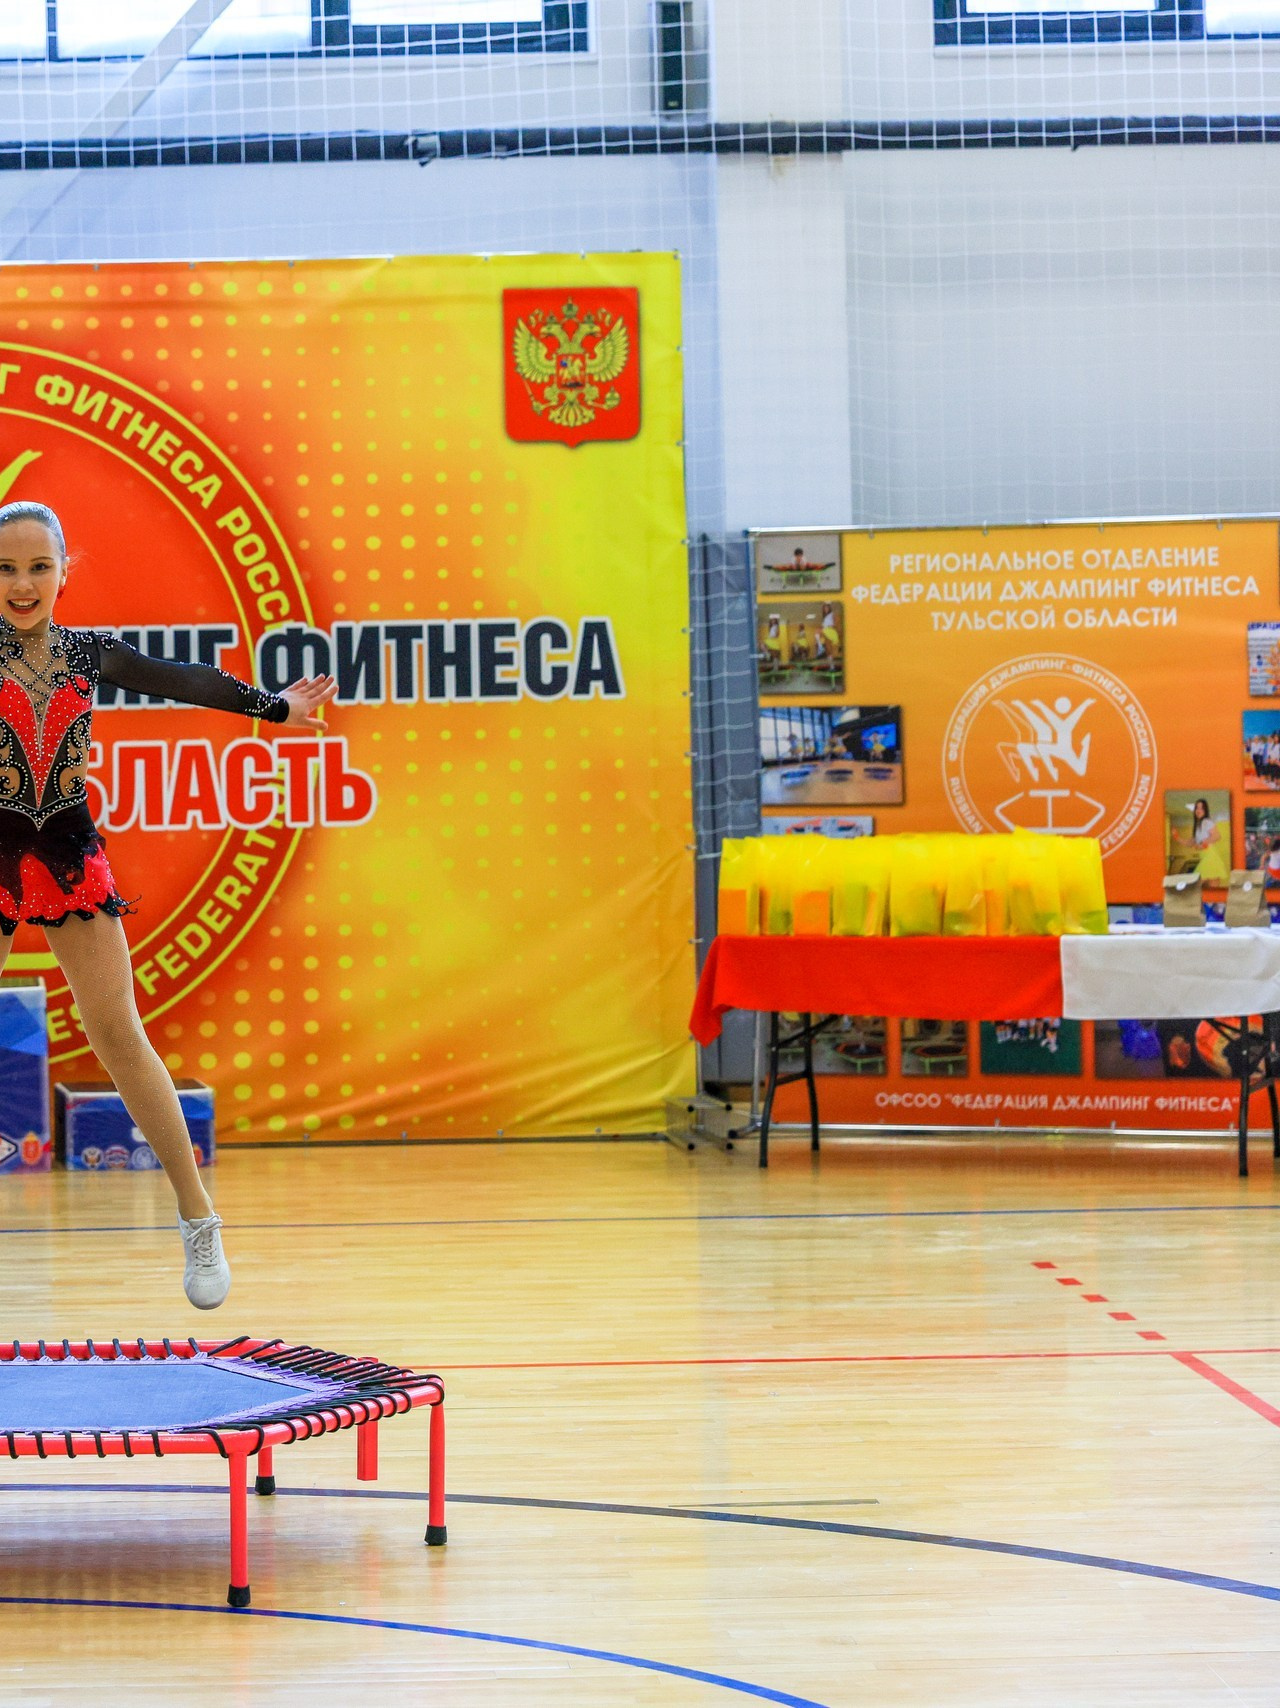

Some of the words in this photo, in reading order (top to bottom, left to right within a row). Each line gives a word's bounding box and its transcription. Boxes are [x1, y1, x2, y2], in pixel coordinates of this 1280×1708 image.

[35, 374, 223, 510] ФИТНЕСА
[216, 506, 295, 631] РОСС
[889, 549, 1075, 575] РЕГИОНАЛЬНОЕ
[1081, 546, 1220, 572] ОТДЕЛЕНИЕ
[851, 581, 993, 605] ФЕДЕРАЦИИ
[999, 577, 1141, 603] ДЖАМПИНГ
[1147, 575, 1261, 599] ФИТНЕСА
[930, 604, 1056, 632] ТУЛЬСКОЙ
[1063, 606, 1178, 629] ОБЛАСТИ
[257, 619, 624, 707] ФИТНЕСА
[86, 738, 376, 832] ЛАСТЬ
[1052, 1093, 1149, 1112] ДЖАМПИНГ
